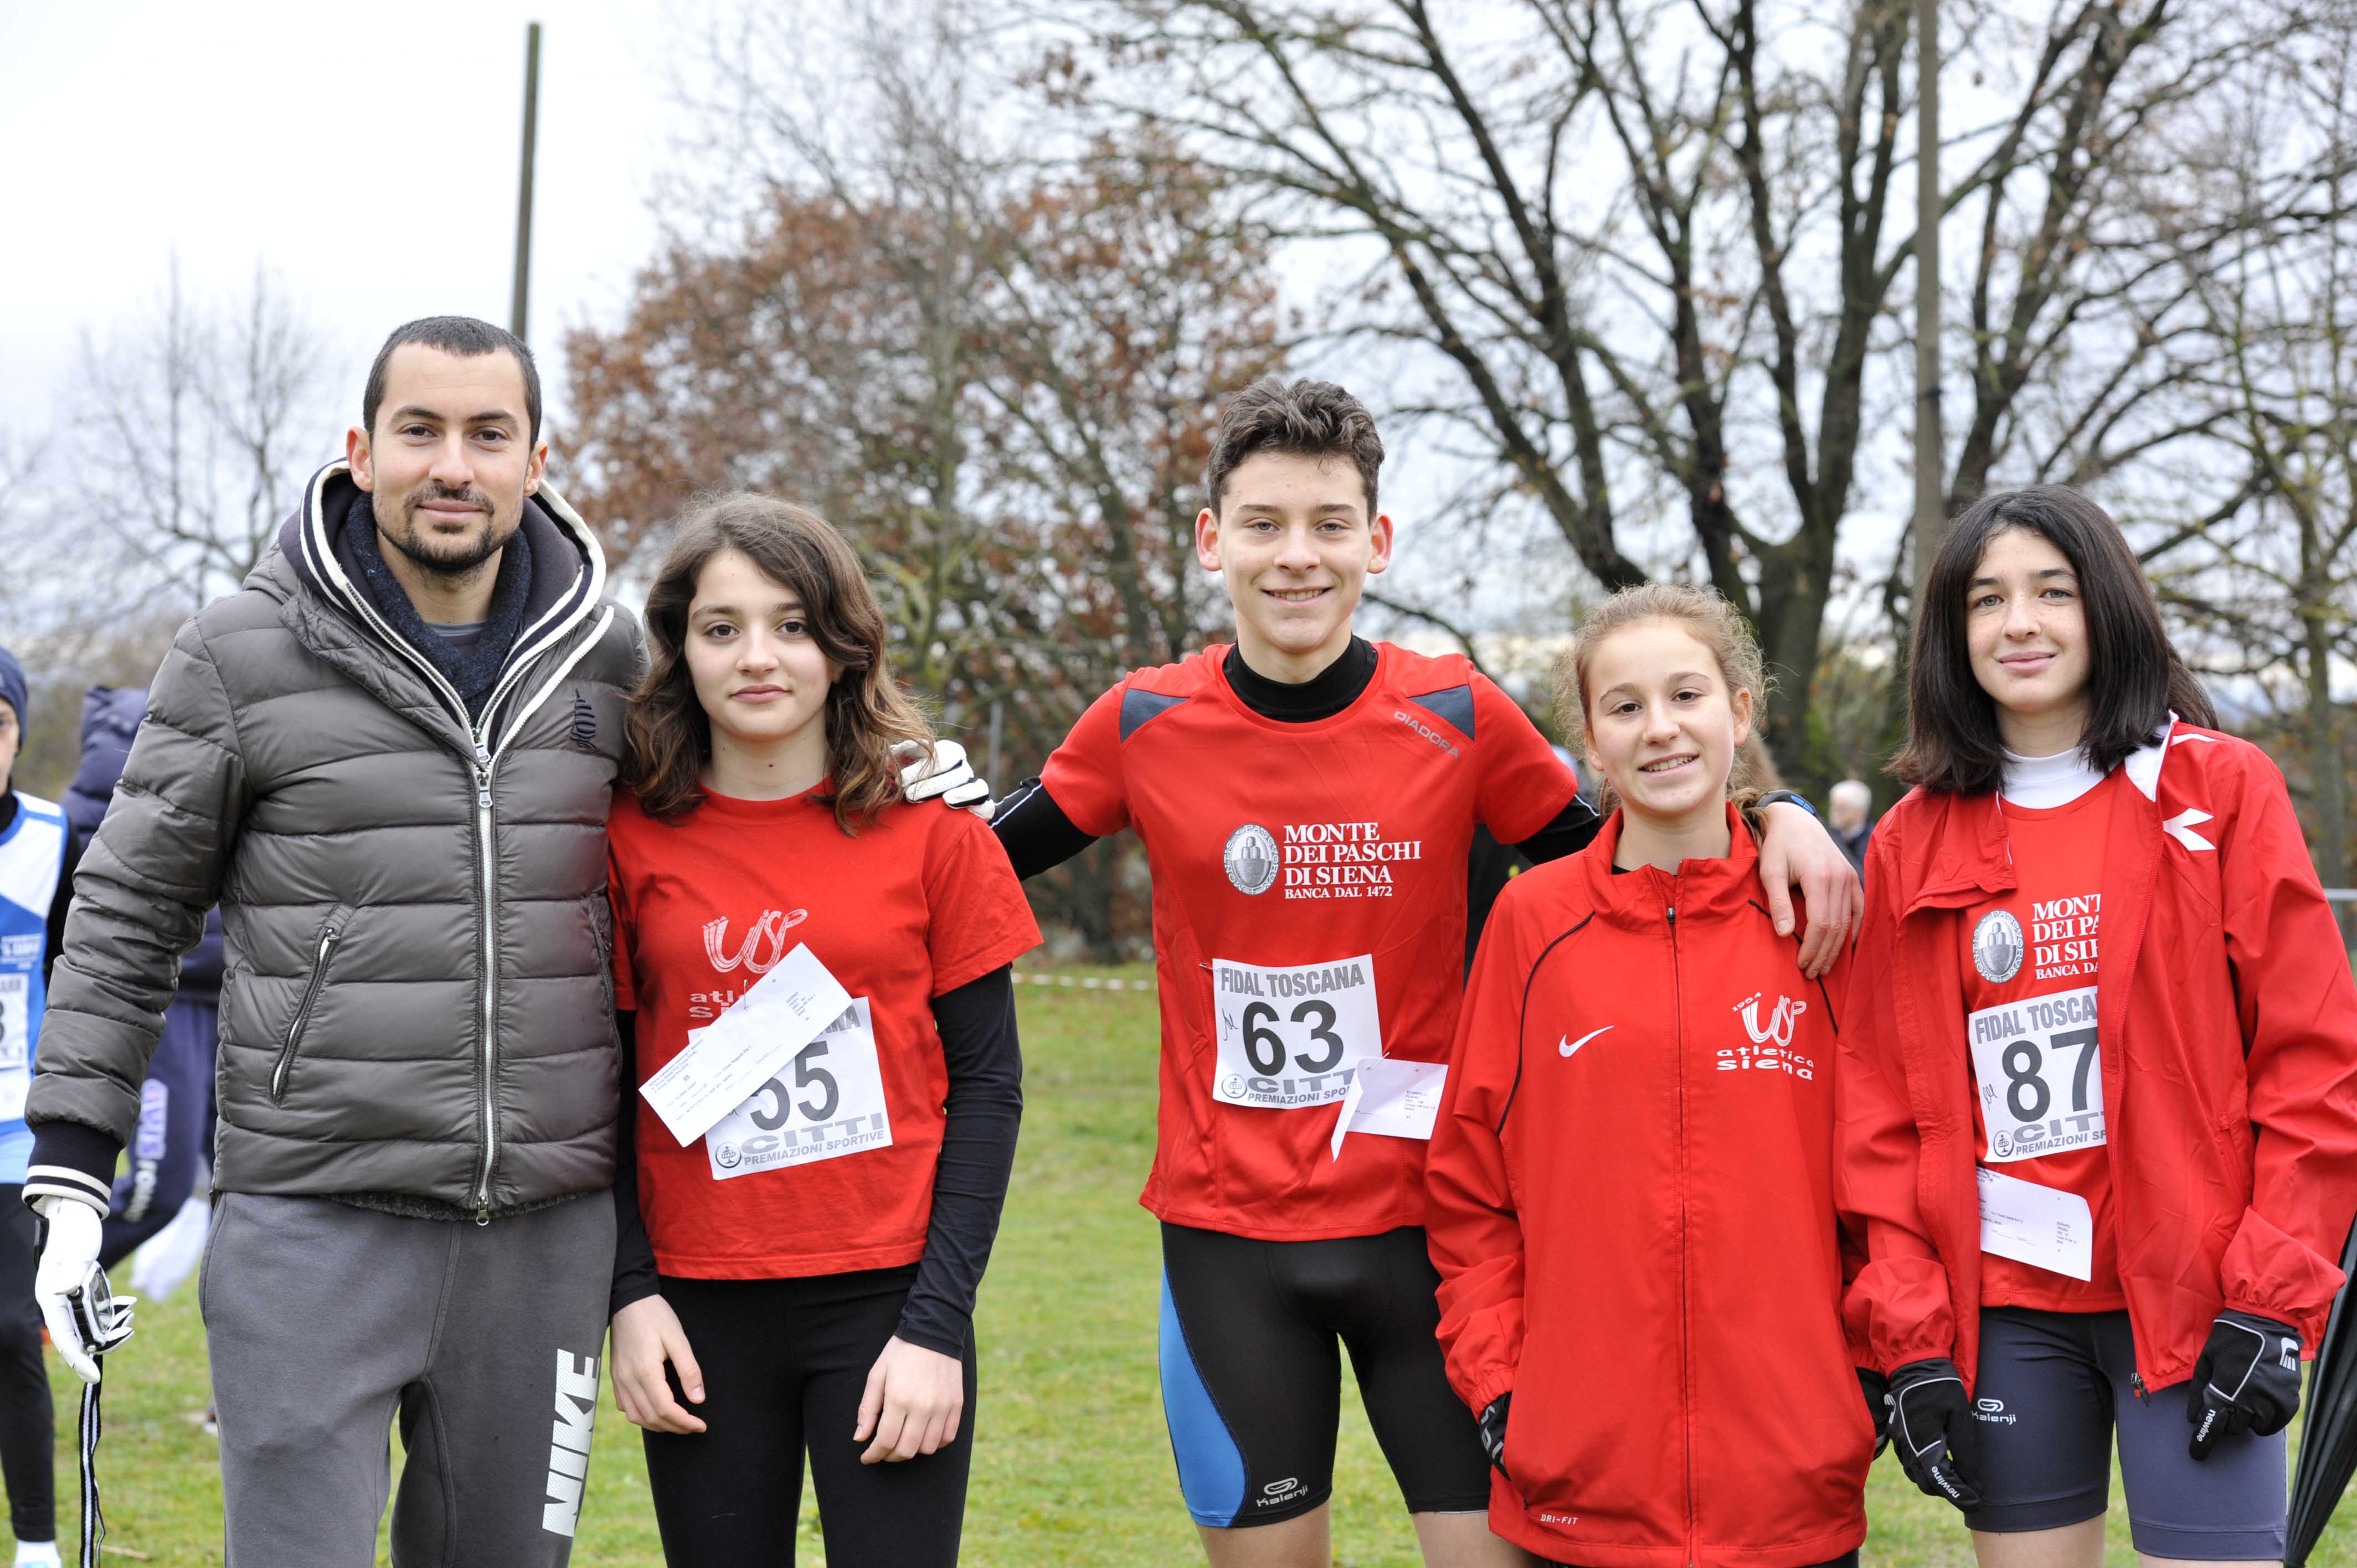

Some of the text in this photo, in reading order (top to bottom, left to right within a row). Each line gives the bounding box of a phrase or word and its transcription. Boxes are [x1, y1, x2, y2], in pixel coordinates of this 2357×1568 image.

[1394, 711, 1458, 759] DIADORA
[1284, 822, 1380, 843] MONTE
[1284, 841, 1421, 864] DEI PASCHI
[1284, 865, 1393, 886] DI SIENA
[1284, 886, 1392, 899] BANCA DAL 1472
[2031, 894, 2101, 921] MONT
[2032, 919, 2075, 942] DEI
[2034, 944, 2062, 966] DI
[1221, 963, 1365, 997] FIDAL TOSCANA
[2035, 961, 2098, 979] BANCA DA
[1975, 994, 2097, 1044] FIDAL TOSCA
[1242, 999, 1344, 1076] 63
[1717, 1045, 1814, 1067] atletica
[1717, 1056, 1813, 1081] siena
[749, 1040, 839, 1131] 55
[1248, 1068, 1356, 1094] CITT
[2002, 1027, 2099, 1122] 87
[1248, 1086, 1350, 1104] PREMIAZIONI SPO
[741, 1112, 883, 1154] CITTI
[2014, 1111, 2105, 1143] CIT
[744, 1130, 884, 1165] PREMIAZIONI SPORTIVE
[2016, 1133, 2087, 1156] PREMIAZIONI
[1972, 1411, 2016, 1425] Kalenji
[2196, 1409, 2216, 1442] newline
[542, 1349, 600, 1537] NIKE
[1932, 1466, 1960, 1498] newline
[1256, 1484, 1308, 1507] Kalenji
[1541, 1514, 1579, 1525] DRI-FIT
